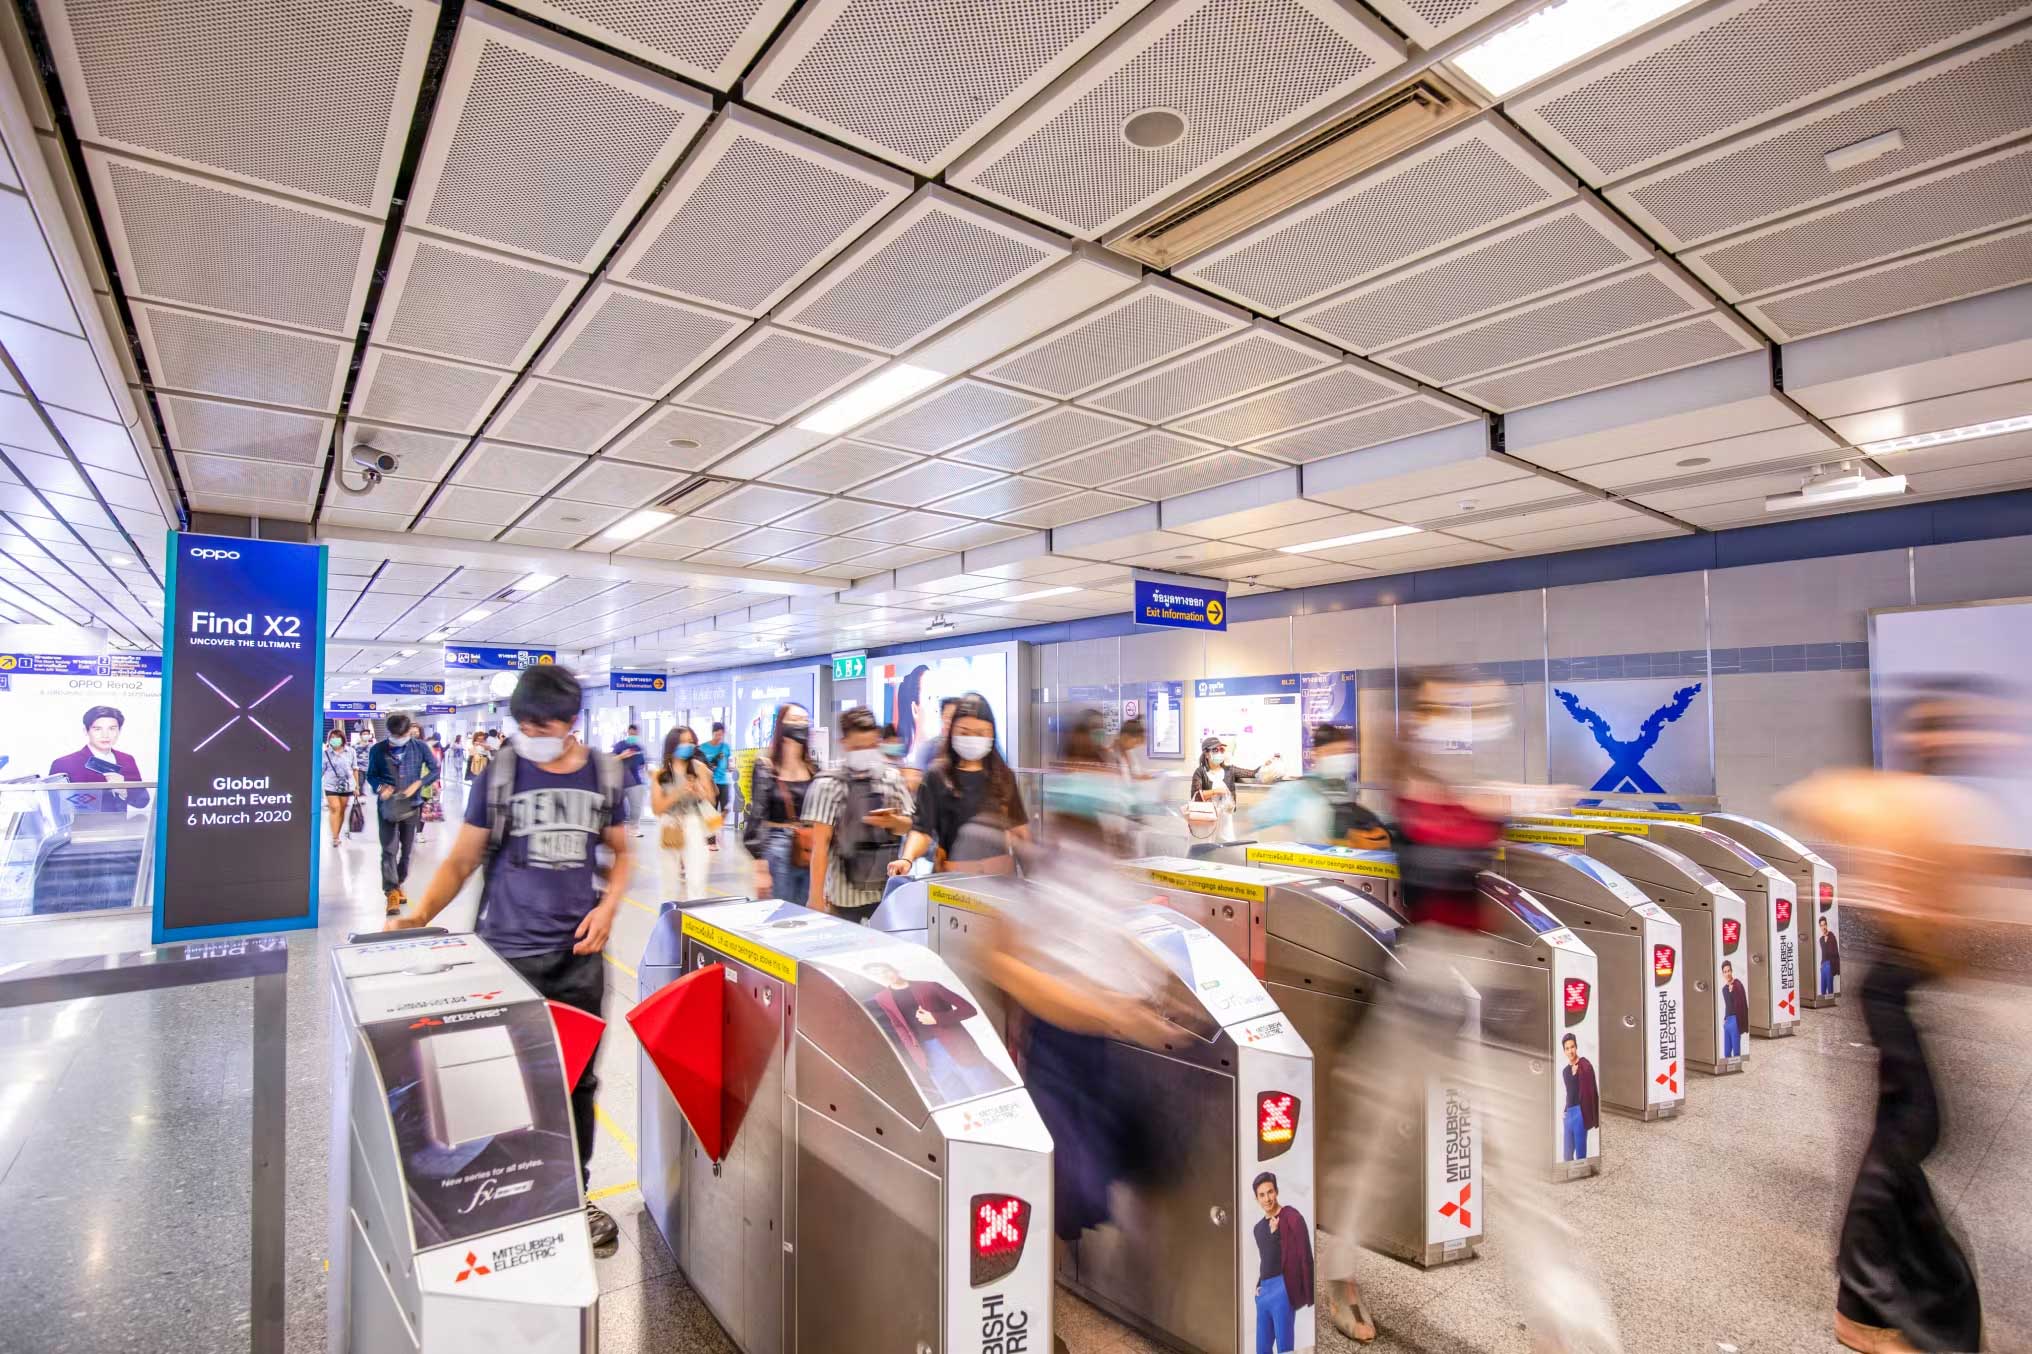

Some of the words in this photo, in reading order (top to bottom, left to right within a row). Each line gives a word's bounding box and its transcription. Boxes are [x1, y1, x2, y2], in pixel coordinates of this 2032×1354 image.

[190, 548, 241, 560] oppo
[1152, 589, 1204, 608] ข้อมูลทางออก
[192, 611, 253, 635] Find
[263, 615, 301, 637] X2
[1146, 607, 1161, 618] Exit
[1162, 608, 1204, 622] Information
[190, 638, 235, 647] UNCOVER
[237, 640, 255, 648] THE
[257, 641, 301, 649] ULTIMATE
[69, 680, 103, 689] OPPO
[107, 681, 143, 690] Reno2
[213, 776, 270, 790] Global
[187, 794, 246, 807] Launch
[250, 793, 292, 805] Event
[187, 813, 198, 826] 6
[202, 811, 250, 825] March
[254, 810, 292, 823] 2020
[1780, 934, 1788, 990] MITSUBISHI
[1787, 942, 1795, 989] ELECTRIC
[1659, 991, 1668, 1060] MITSUBISHI
[1667, 999, 1677, 1059] ELECTRIC
[1446, 1089, 1459, 1184] MITSUBISHI
[1458, 1098, 1472, 1181] ELECTRIC
[441, 1178, 463, 1188] New
[464, 1171, 491, 1183] series
[492, 1167, 505, 1177] for
[506, 1163, 517, 1174] all
[492, 1232, 565, 1261] MITSUBISHI
[494, 1246, 557, 1272] ELECTRIC
